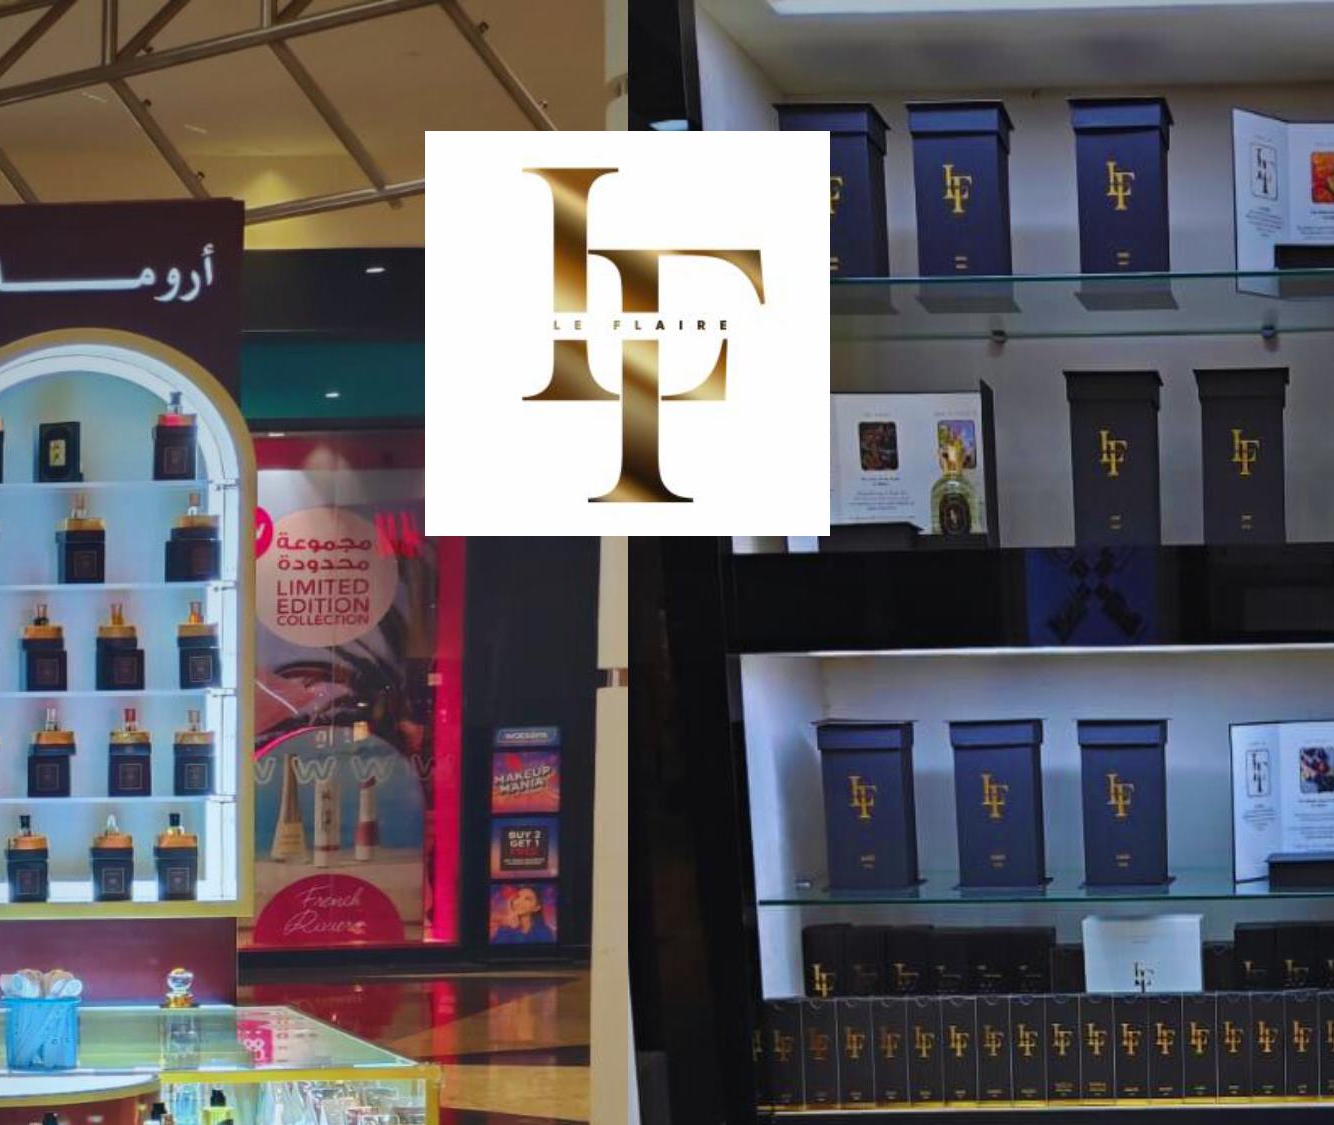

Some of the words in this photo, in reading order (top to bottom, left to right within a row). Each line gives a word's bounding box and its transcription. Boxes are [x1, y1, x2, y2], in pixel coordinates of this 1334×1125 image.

[277, 532, 372, 553] مجموعة
[278, 554, 370, 573] محدودة
[277, 579, 369, 596] LIMITED
[277, 598, 369, 614] EDITION
[277, 614, 369, 626] COLLECTION
[494, 765, 552, 785] MAKEUP
[508, 830, 532, 839] BUY
[535, 830, 541, 839] 2
[510, 839, 531, 848] GET
[297, 885, 364, 908] French
